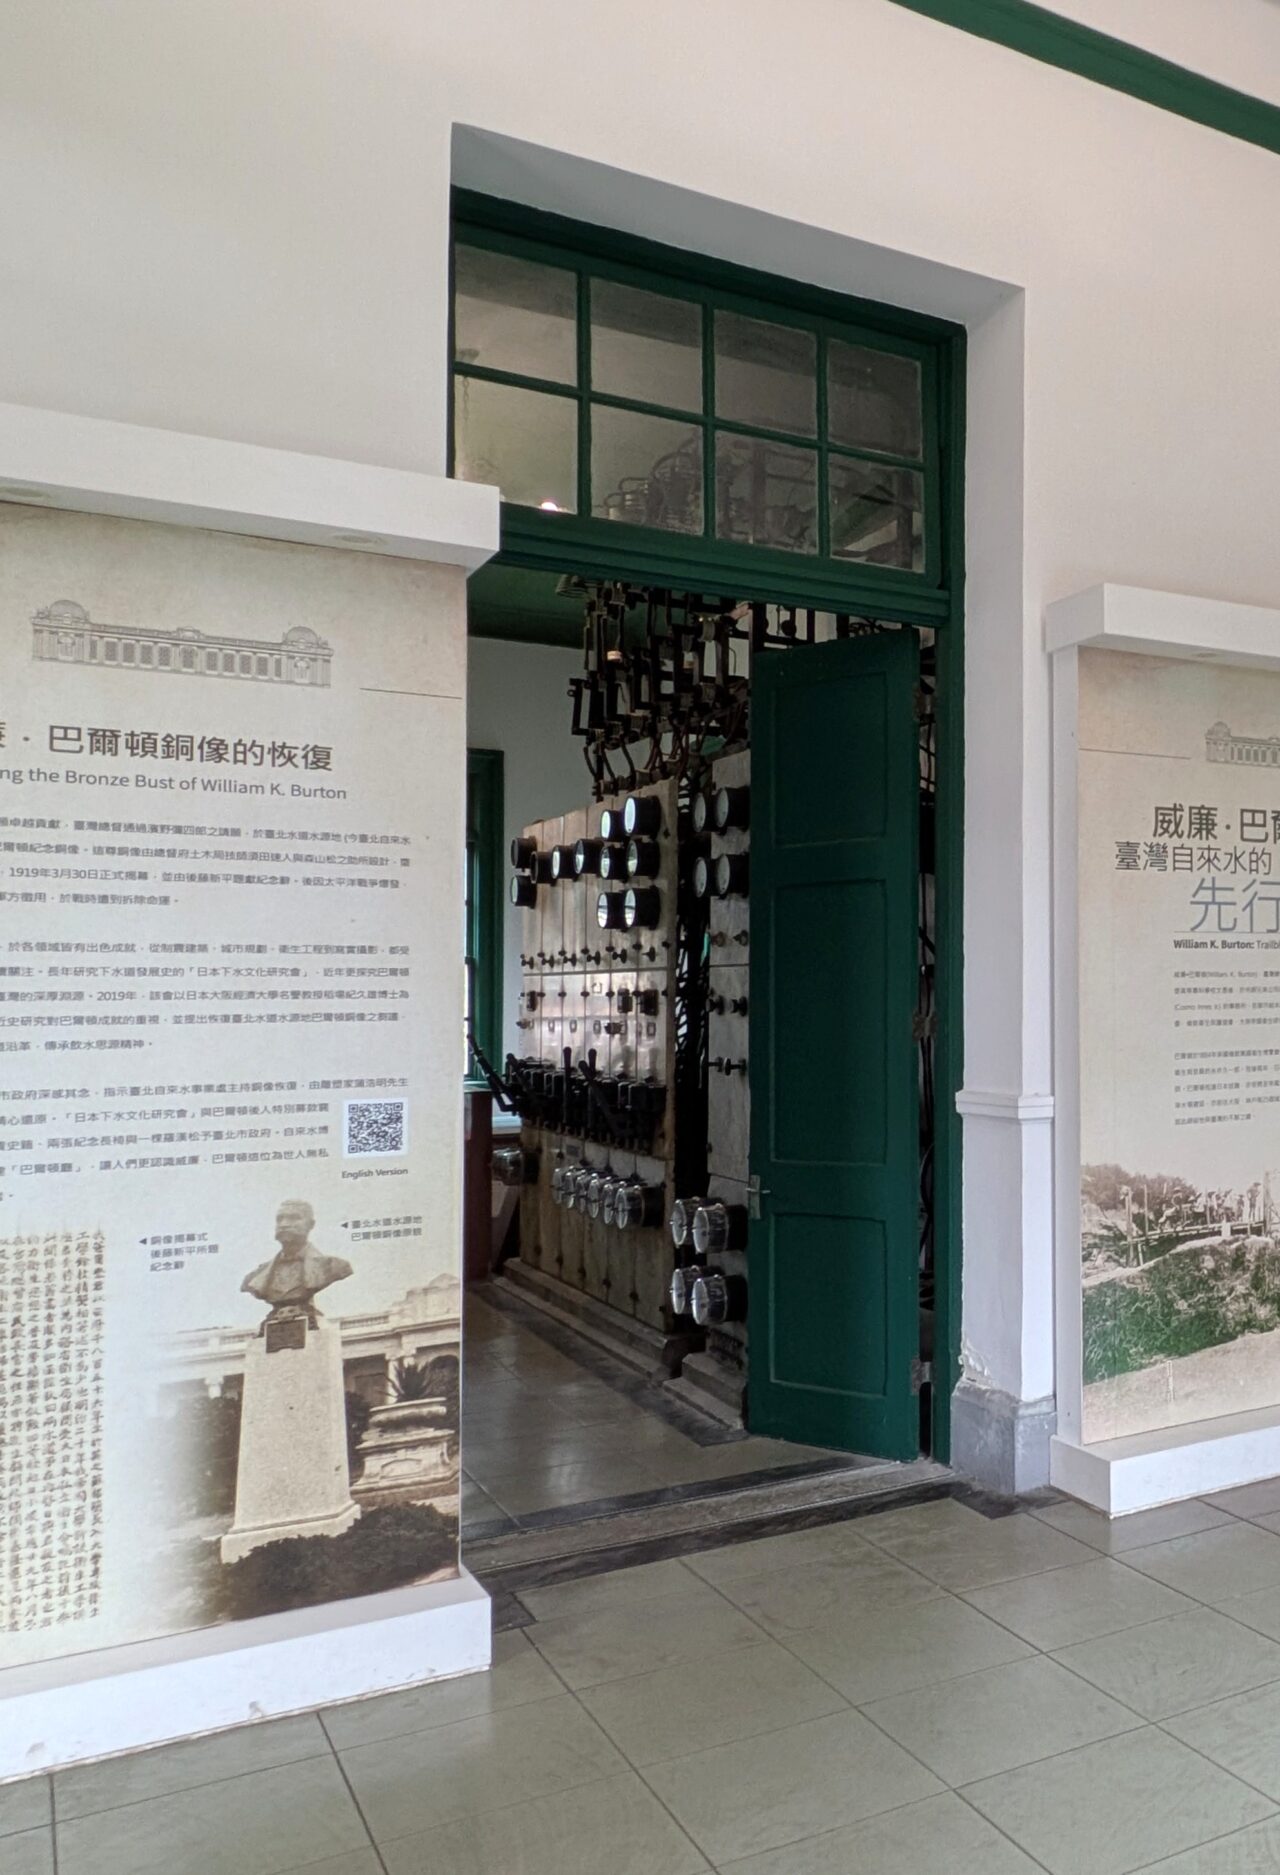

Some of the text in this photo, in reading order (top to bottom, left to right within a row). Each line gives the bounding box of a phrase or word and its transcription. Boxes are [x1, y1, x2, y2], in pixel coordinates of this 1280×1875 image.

[0, 722, 333, 772] ·巴爾頓銅像的恢復
[29, 768, 59, 782] the
[66, 770, 130, 787] Bronze
[135, 775, 175, 789] Bust
[179, 777, 197, 791] of
[201, 779, 264, 795] William
[270, 783, 285, 796] K.
[291, 784, 347, 799] Burton
[1114, 841, 1272, 875] 臺灣自來水的
[1173, 939, 1208, 950] William
[1210, 940, 1219, 950] K.
[1221, 940, 1255, 950] Burton:
[342, 1167, 408, 1180] English Version
